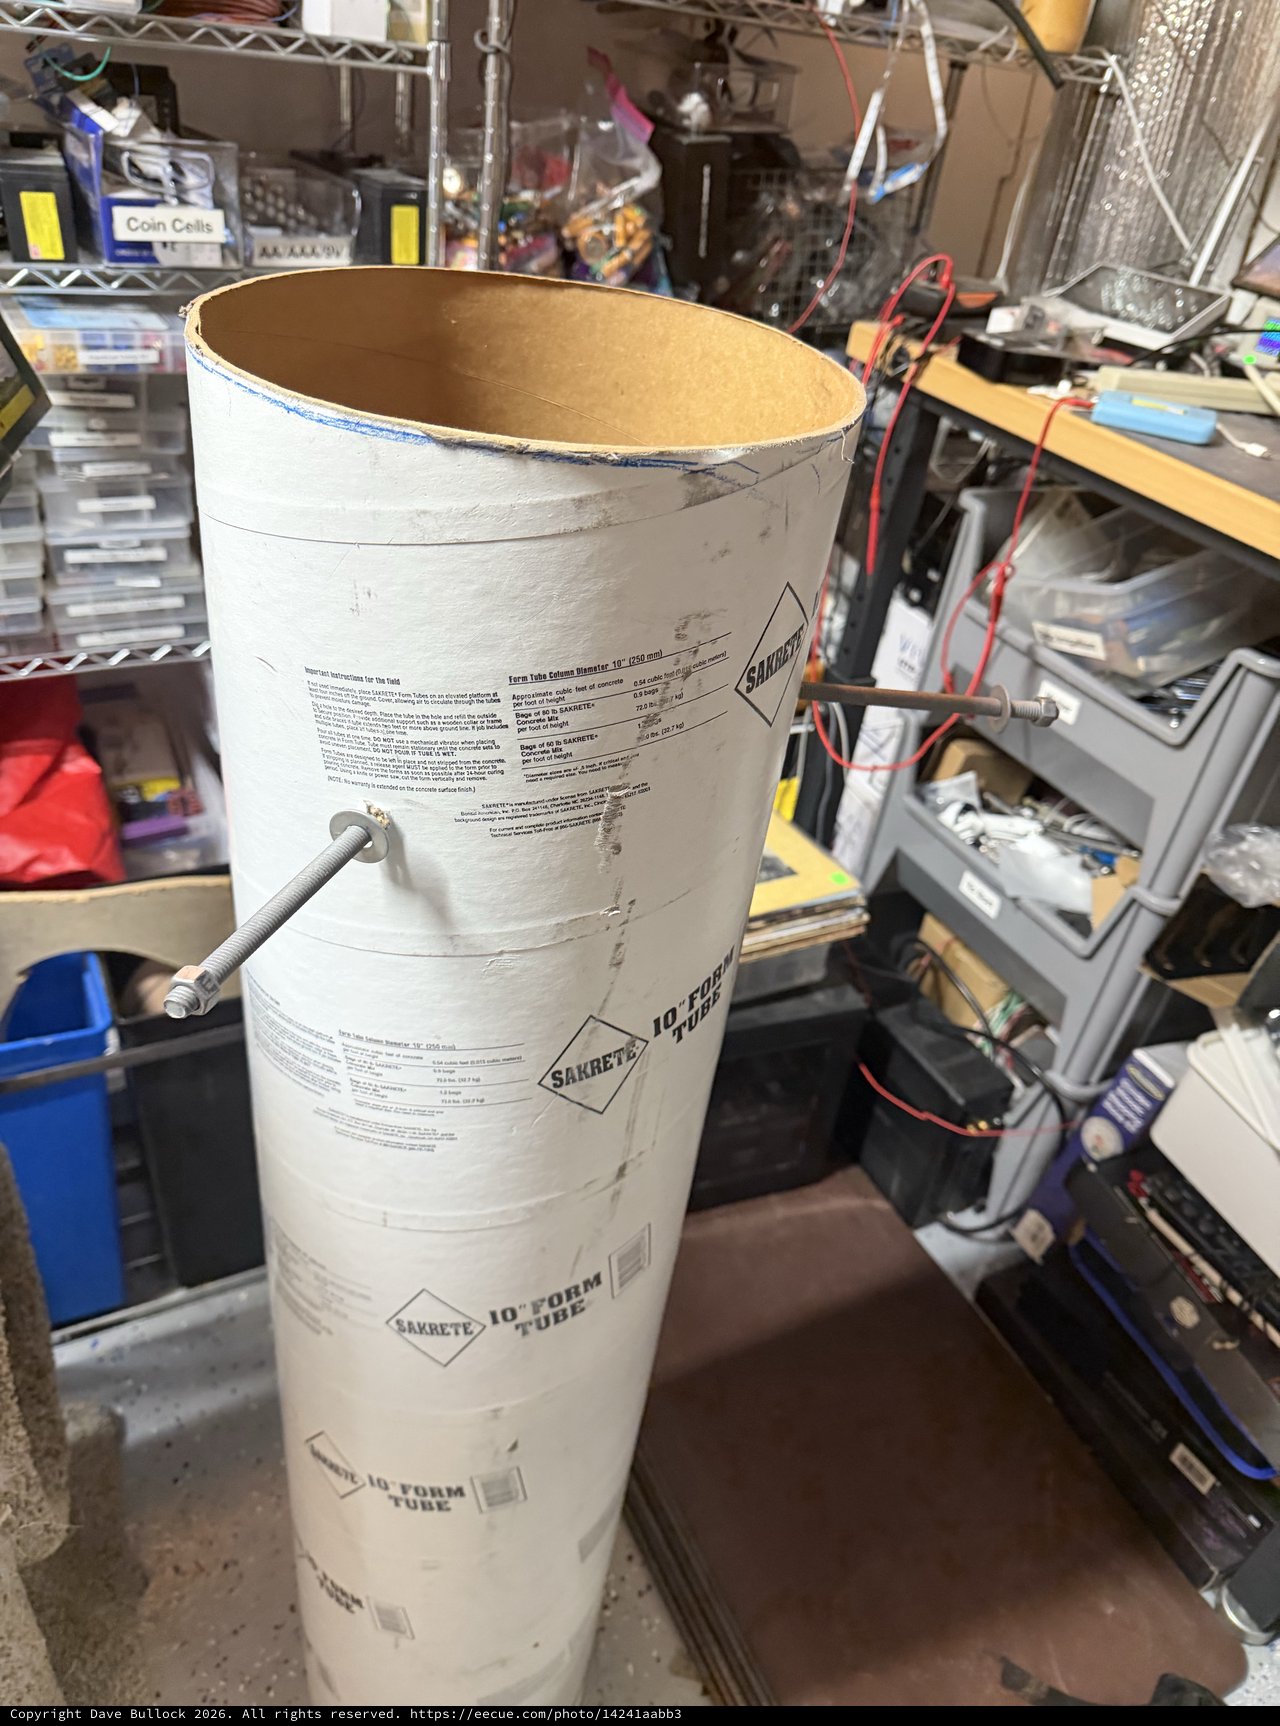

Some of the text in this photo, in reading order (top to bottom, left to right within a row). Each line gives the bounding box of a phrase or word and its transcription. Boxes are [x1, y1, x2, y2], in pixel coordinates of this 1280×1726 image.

[126, 217, 213, 233] Coin Cells
[549, 670, 574, 679] Column
[576, 663, 609, 675] Diameter
[612, 658, 625, 668] 10"
[629, 654, 645, 666] (250
[647, 650, 662, 660] mm)
[647, 674, 662, 683] cubic
[693, 660, 706, 669] cubic
[708, 651, 726, 663] meters)
[746, 623, 804, 694] SAKRETE
[304, 666, 329, 677] Important
[512, 691, 552, 701] Approximate
[598, 678, 623, 688] concrete
[644, 688, 658, 696] bags
[675, 692, 683, 700] kg)
[676, 722, 684, 731] kg)
[554, 752, 572, 760] height
[688, 944, 735, 1012] FORM
[672, 982, 722, 1044] TUBE
[551, 1046, 637, 1088] SAKRETE
[395, 1318, 474, 1337] SAKRETE
[531, 1271, 602, 1315] FORM
[514, 1299, 586, 1337] TUBE
[400, 1483, 466, 1498] FORM
[388, 1495, 452, 1512] TUBE
